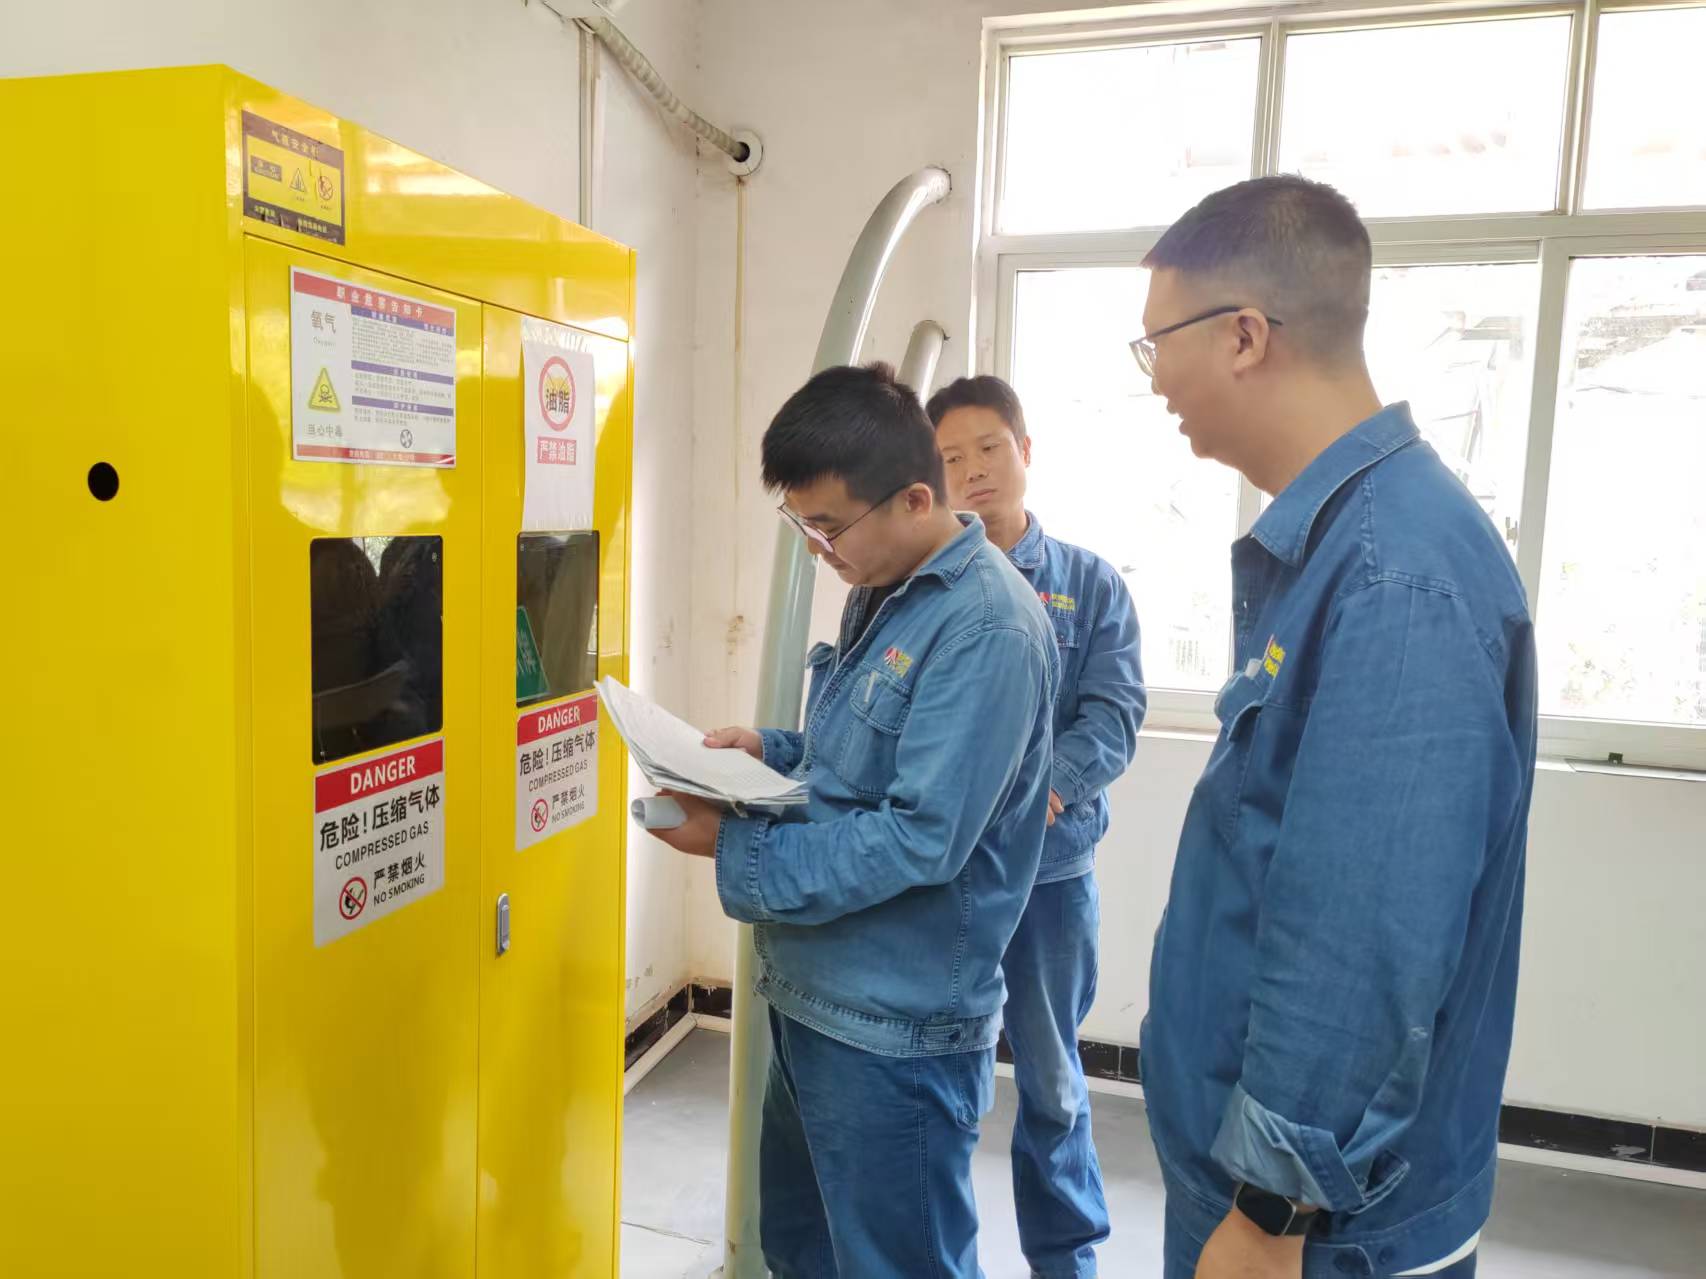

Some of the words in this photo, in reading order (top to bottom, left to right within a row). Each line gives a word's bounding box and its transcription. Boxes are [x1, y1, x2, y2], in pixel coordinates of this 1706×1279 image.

[546, 388, 570, 414] 油脂
[306, 423, 344, 438] 当心中毒
[540, 440, 575, 463] 严禁油脂
[538, 705, 580, 734] DANGER
[350, 755, 416, 794] DANGER
[528, 766, 574, 792] COMPRESSED
[575, 759, 588, 773] GAS
[552, 783, 585, 810] 严禁烟火
[552, 812, 561, 824] NO
[562, 802, 585, 818] SMOKING
[335, 829, 408, 870] COMPRESSED
[409, 821, 429, 840] GAS
[373, 851, 426, 890] 严禁烟火
[373, 891, 387, 907] NO
[388, 873, 425, 900] SMOKING
